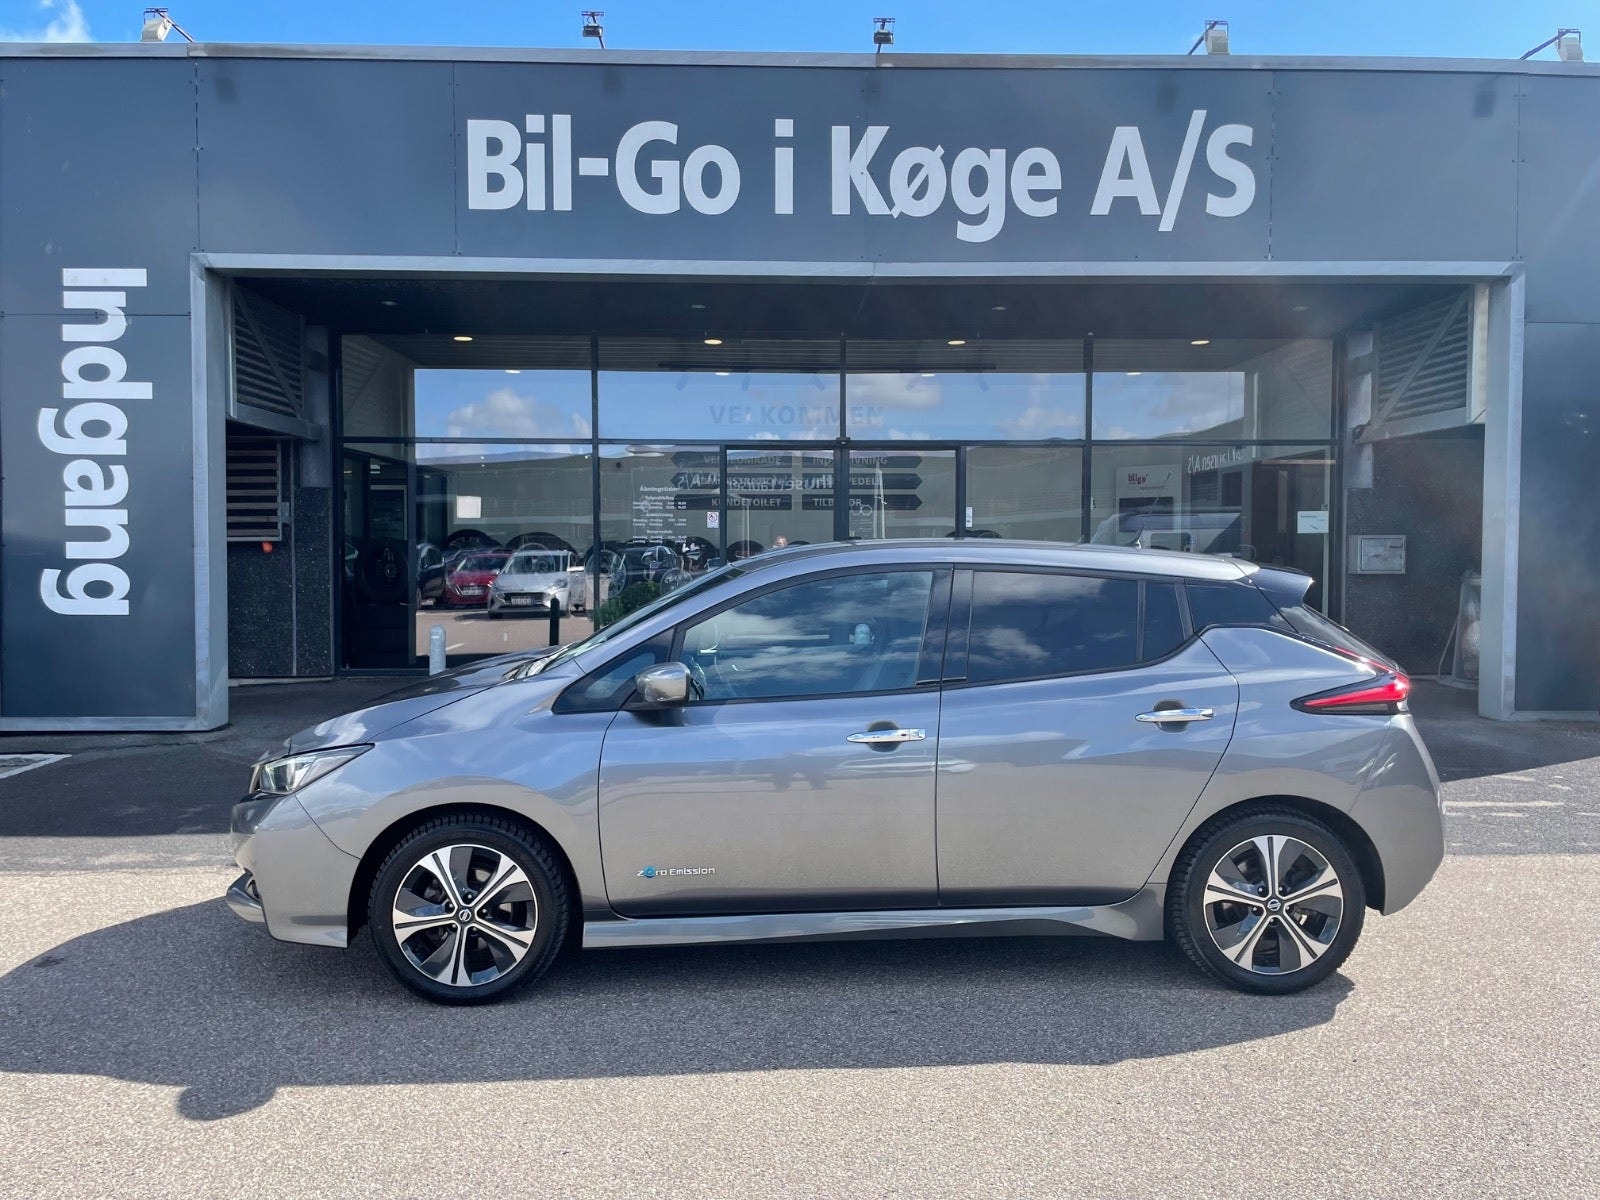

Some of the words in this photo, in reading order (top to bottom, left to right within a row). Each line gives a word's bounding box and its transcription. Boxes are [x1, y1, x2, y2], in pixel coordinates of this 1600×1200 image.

[467, 114, 741, 215] Bil-Go
[774, 118, 794, 215] i
[831, 125, 1062, 243] Køge
[1089, 109, 1256, 232] A/S
[37, 268, 153, 615] Indgang
[711, 498, 781, 507] KNDETOILET
[813, 498, 862, 507] TILBØR
[669, 867, 716, 876] Emission
